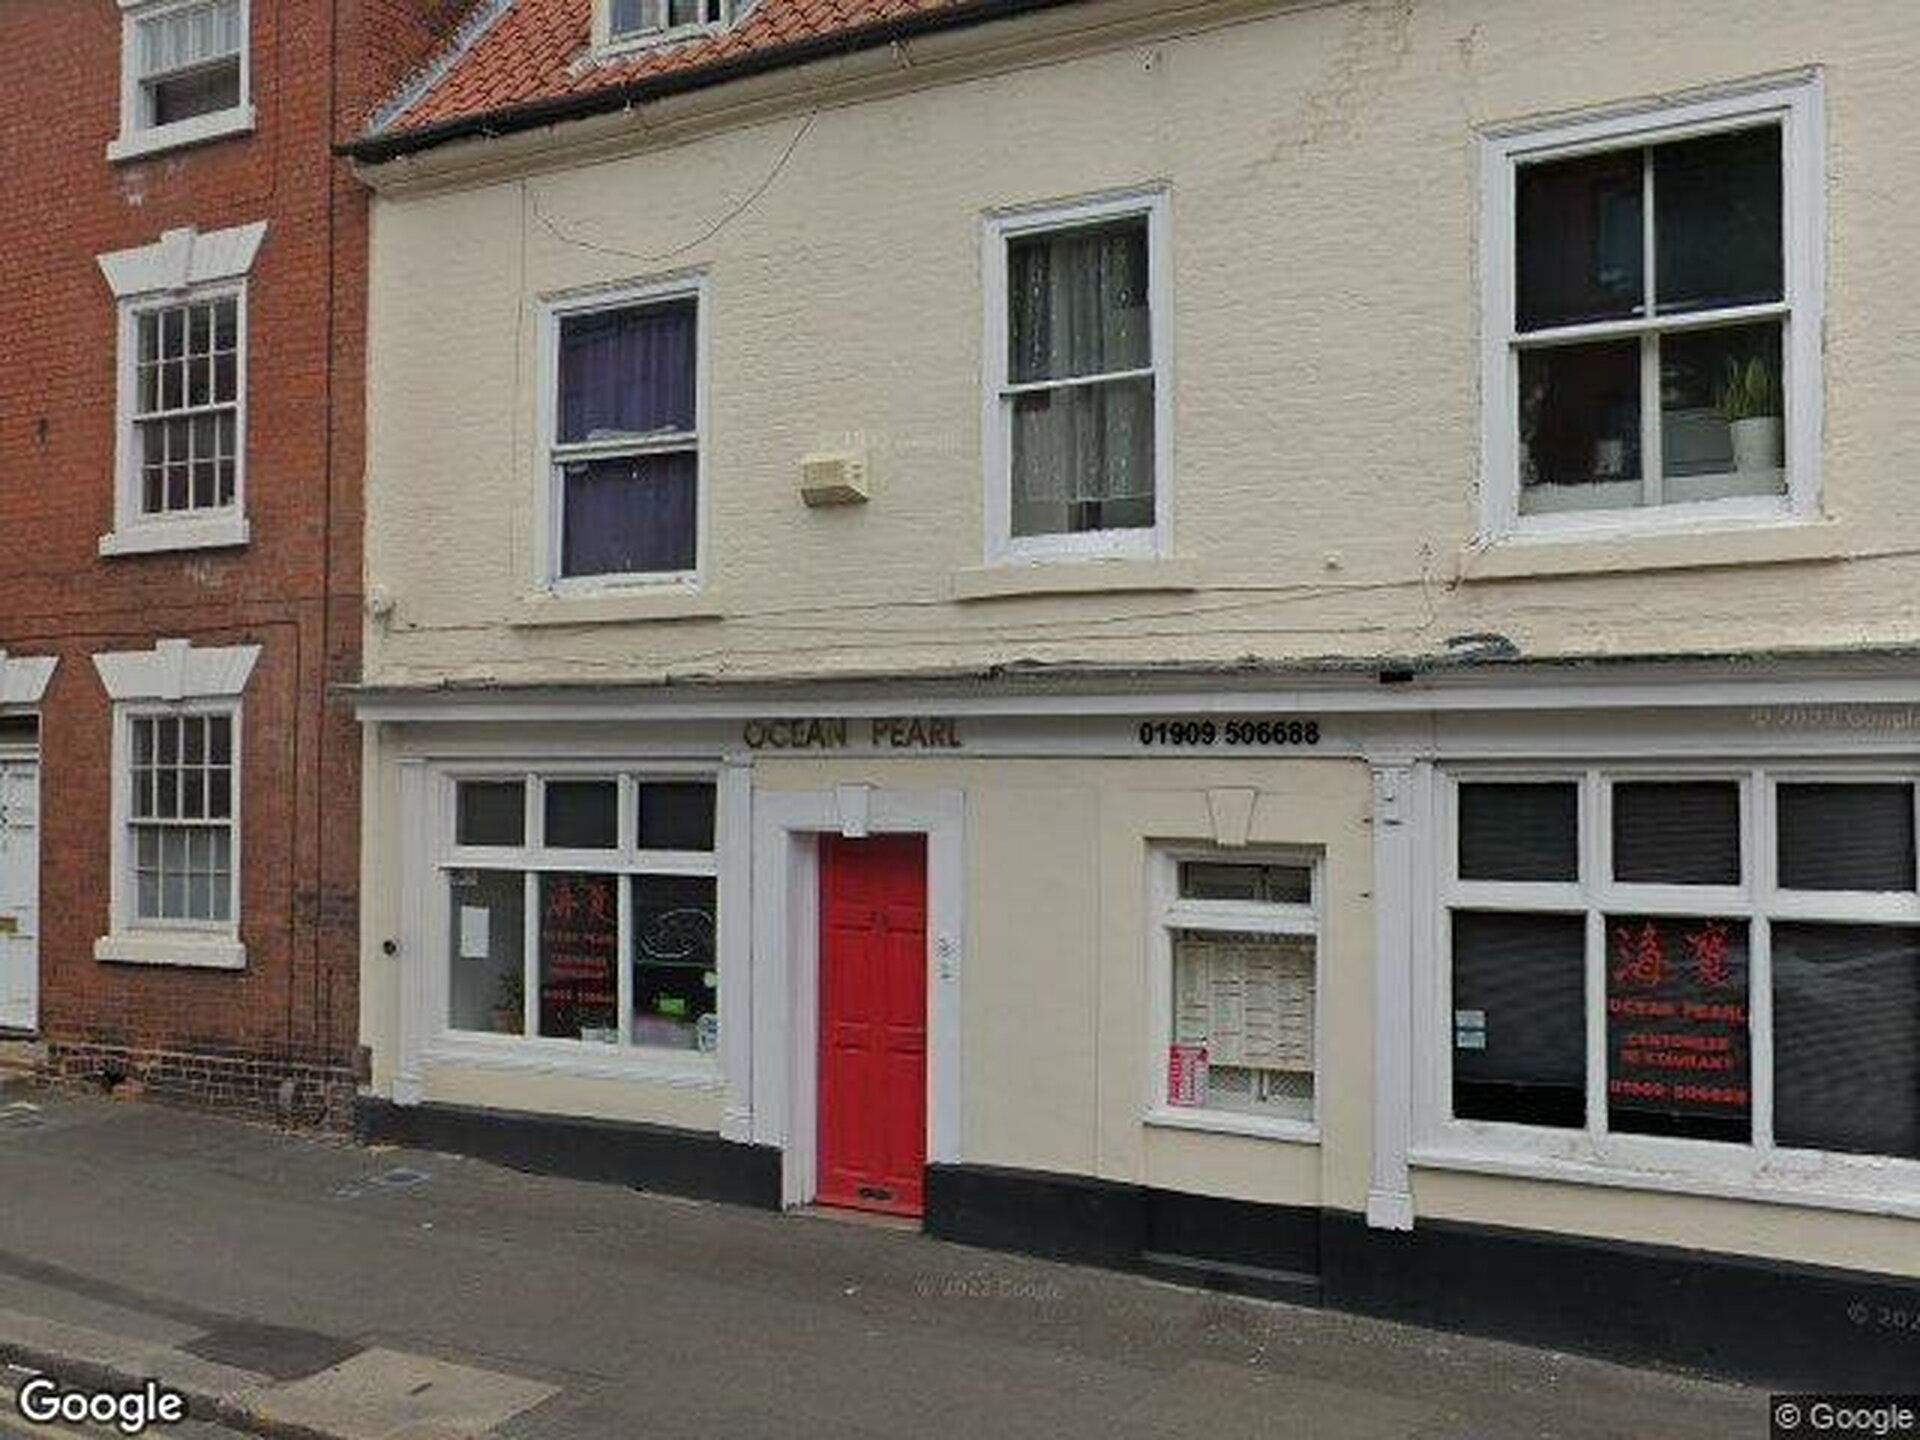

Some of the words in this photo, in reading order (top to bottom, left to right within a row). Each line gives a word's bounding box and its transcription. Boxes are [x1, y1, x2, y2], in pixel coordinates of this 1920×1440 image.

[743, 718, 848, 748] OCEAN
[871, 717, 962, 748] PEARL
[1139, 721, 1216, 746] 01909
[1225, 721, 1320, 745] 506688
